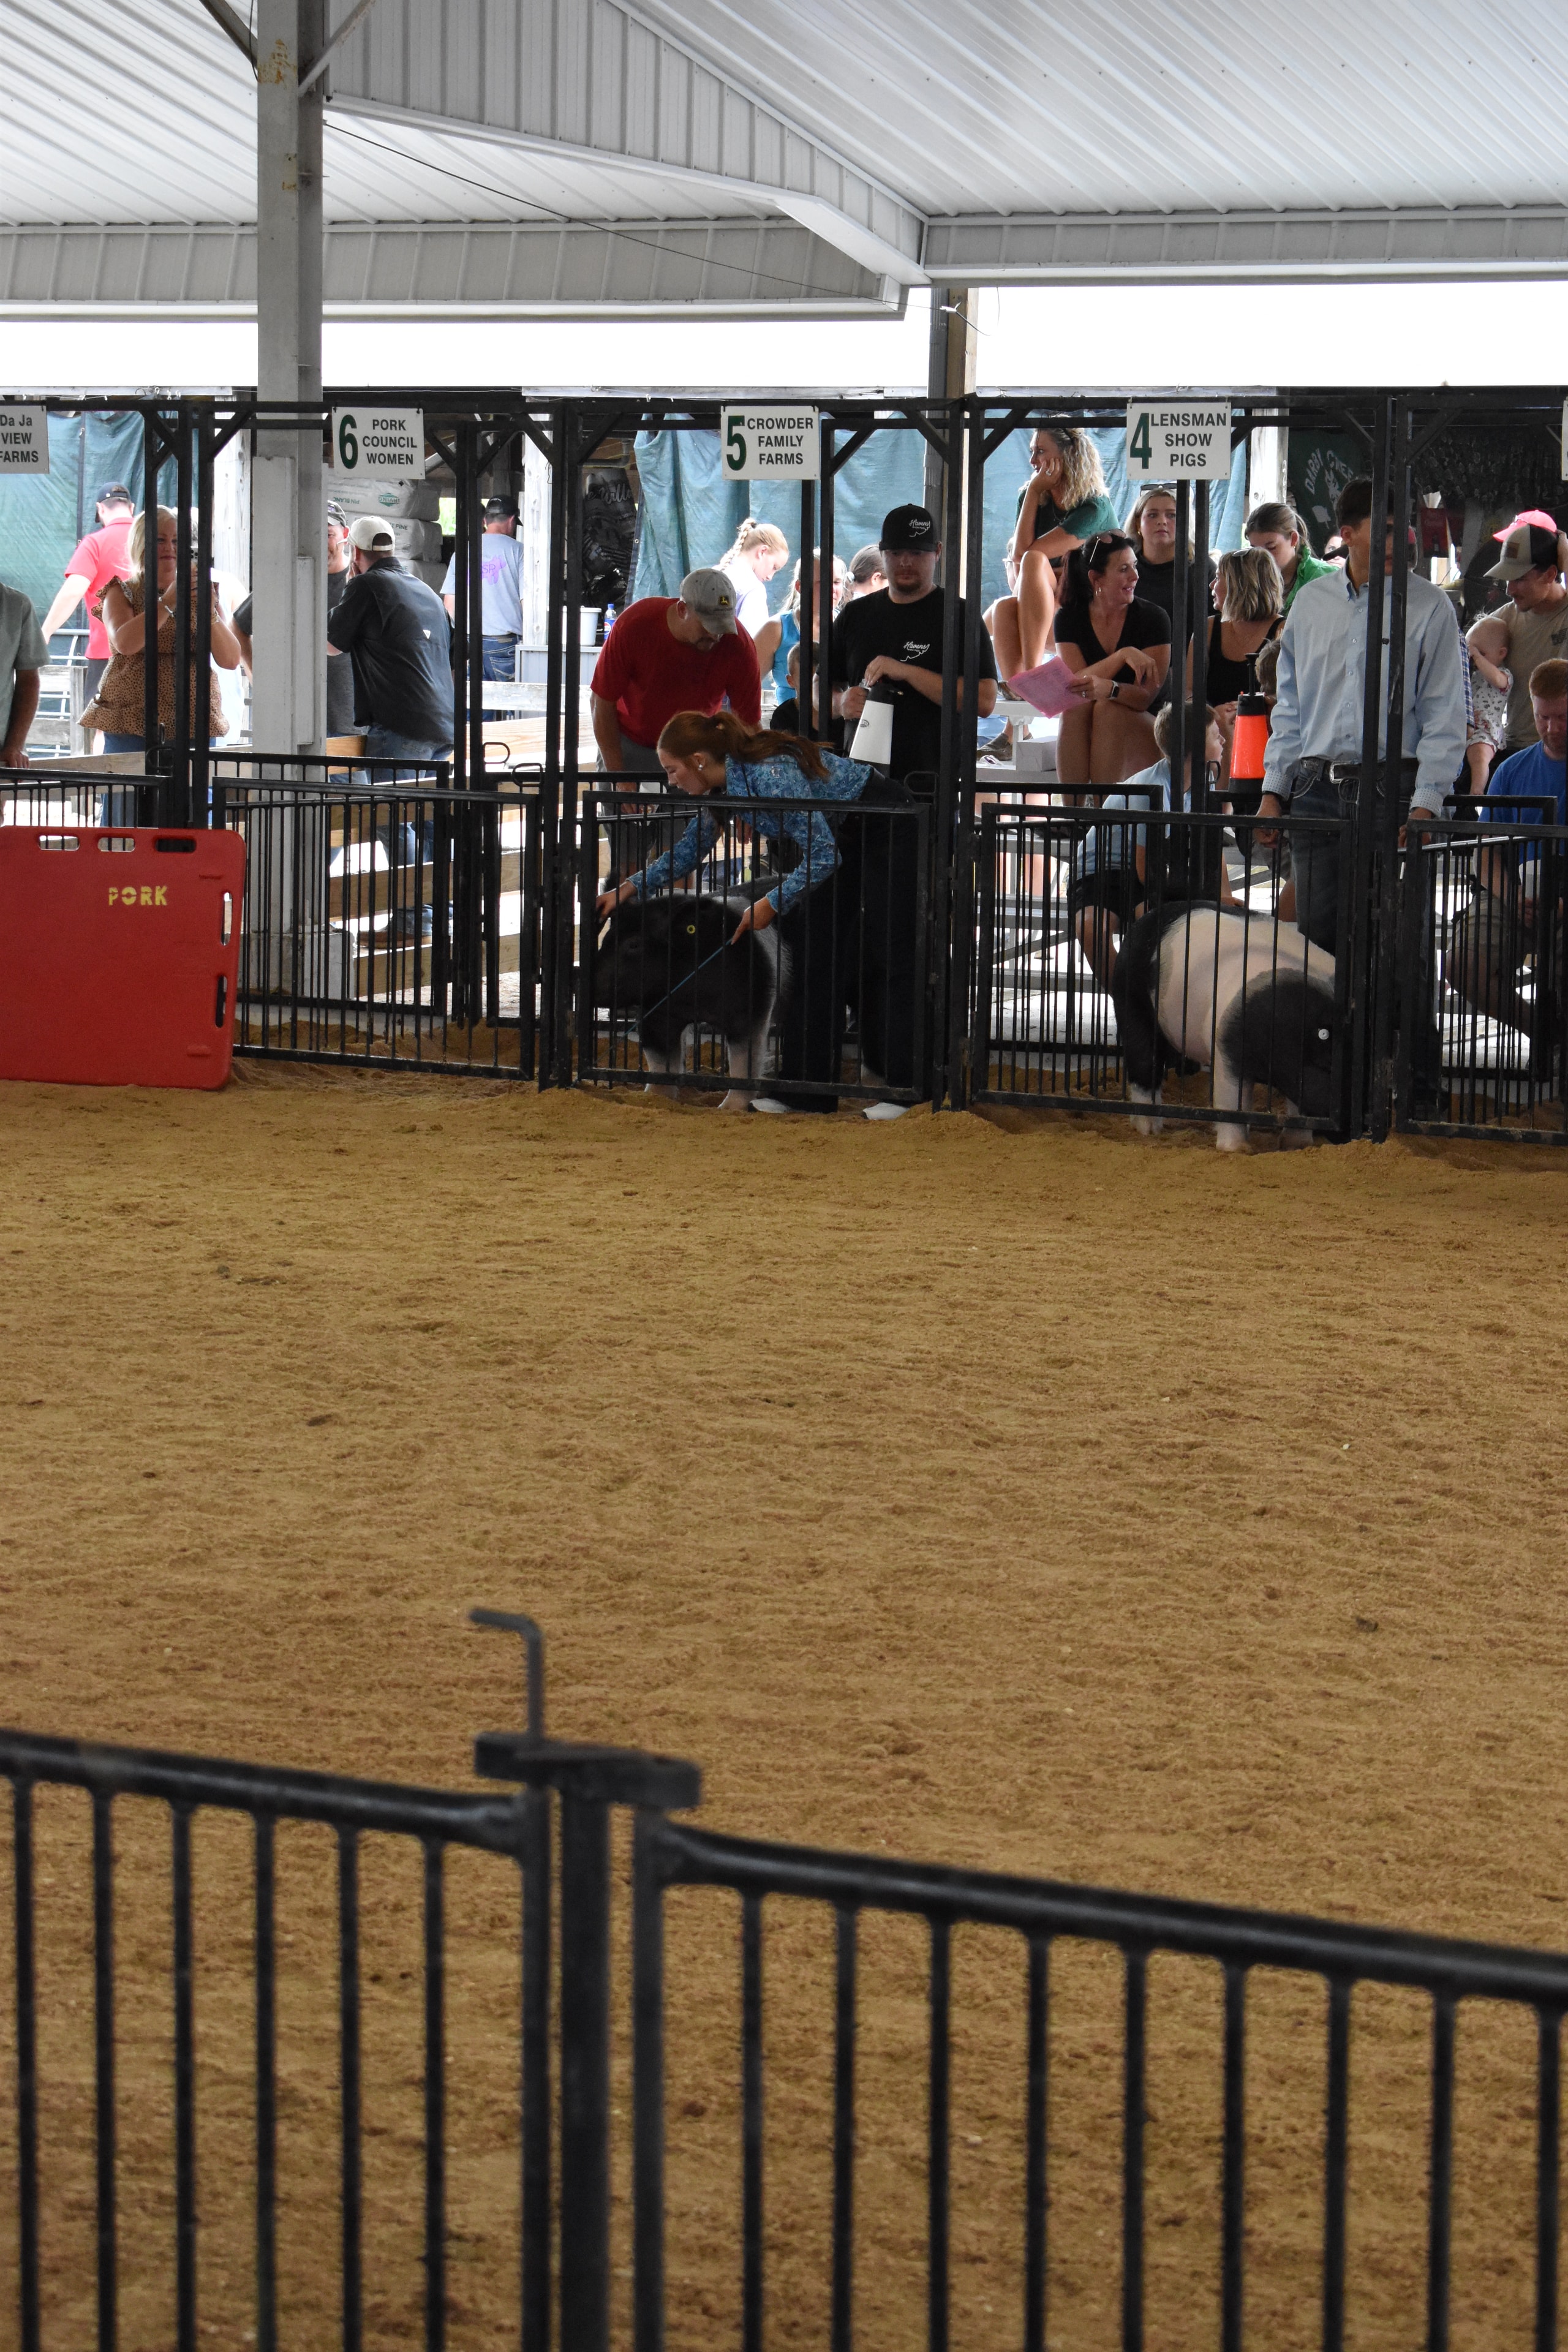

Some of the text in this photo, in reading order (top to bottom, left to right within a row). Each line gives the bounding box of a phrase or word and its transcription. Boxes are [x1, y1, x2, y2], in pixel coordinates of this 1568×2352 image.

[0, 415, 32, 426] Da Ja
[372, 419, 407, 431] PORK
[747, 418, 813, 430] CROWDER
[1151, 413, 1227, 427] LENSMAN
[1, 432, 32, 445] VIEW
[339, 414, 359, 470] 6
[363, 435, 418, 448] COUNCIL
[726, 415, 747, 472] 5
[758, 435, 804, 447] FAMILY
[1130, 413, 1152, 469] 4
[1165, 433, 1213, 447] SHOW
[366, 453, 414, 466] WOMEN
[760, 453, 804, 465] FARMS
[1170, 453, 1207, 467] PIGS
[1305, 448, 1324, 495] DARBY
[108, 885, 167, 906] PORK
